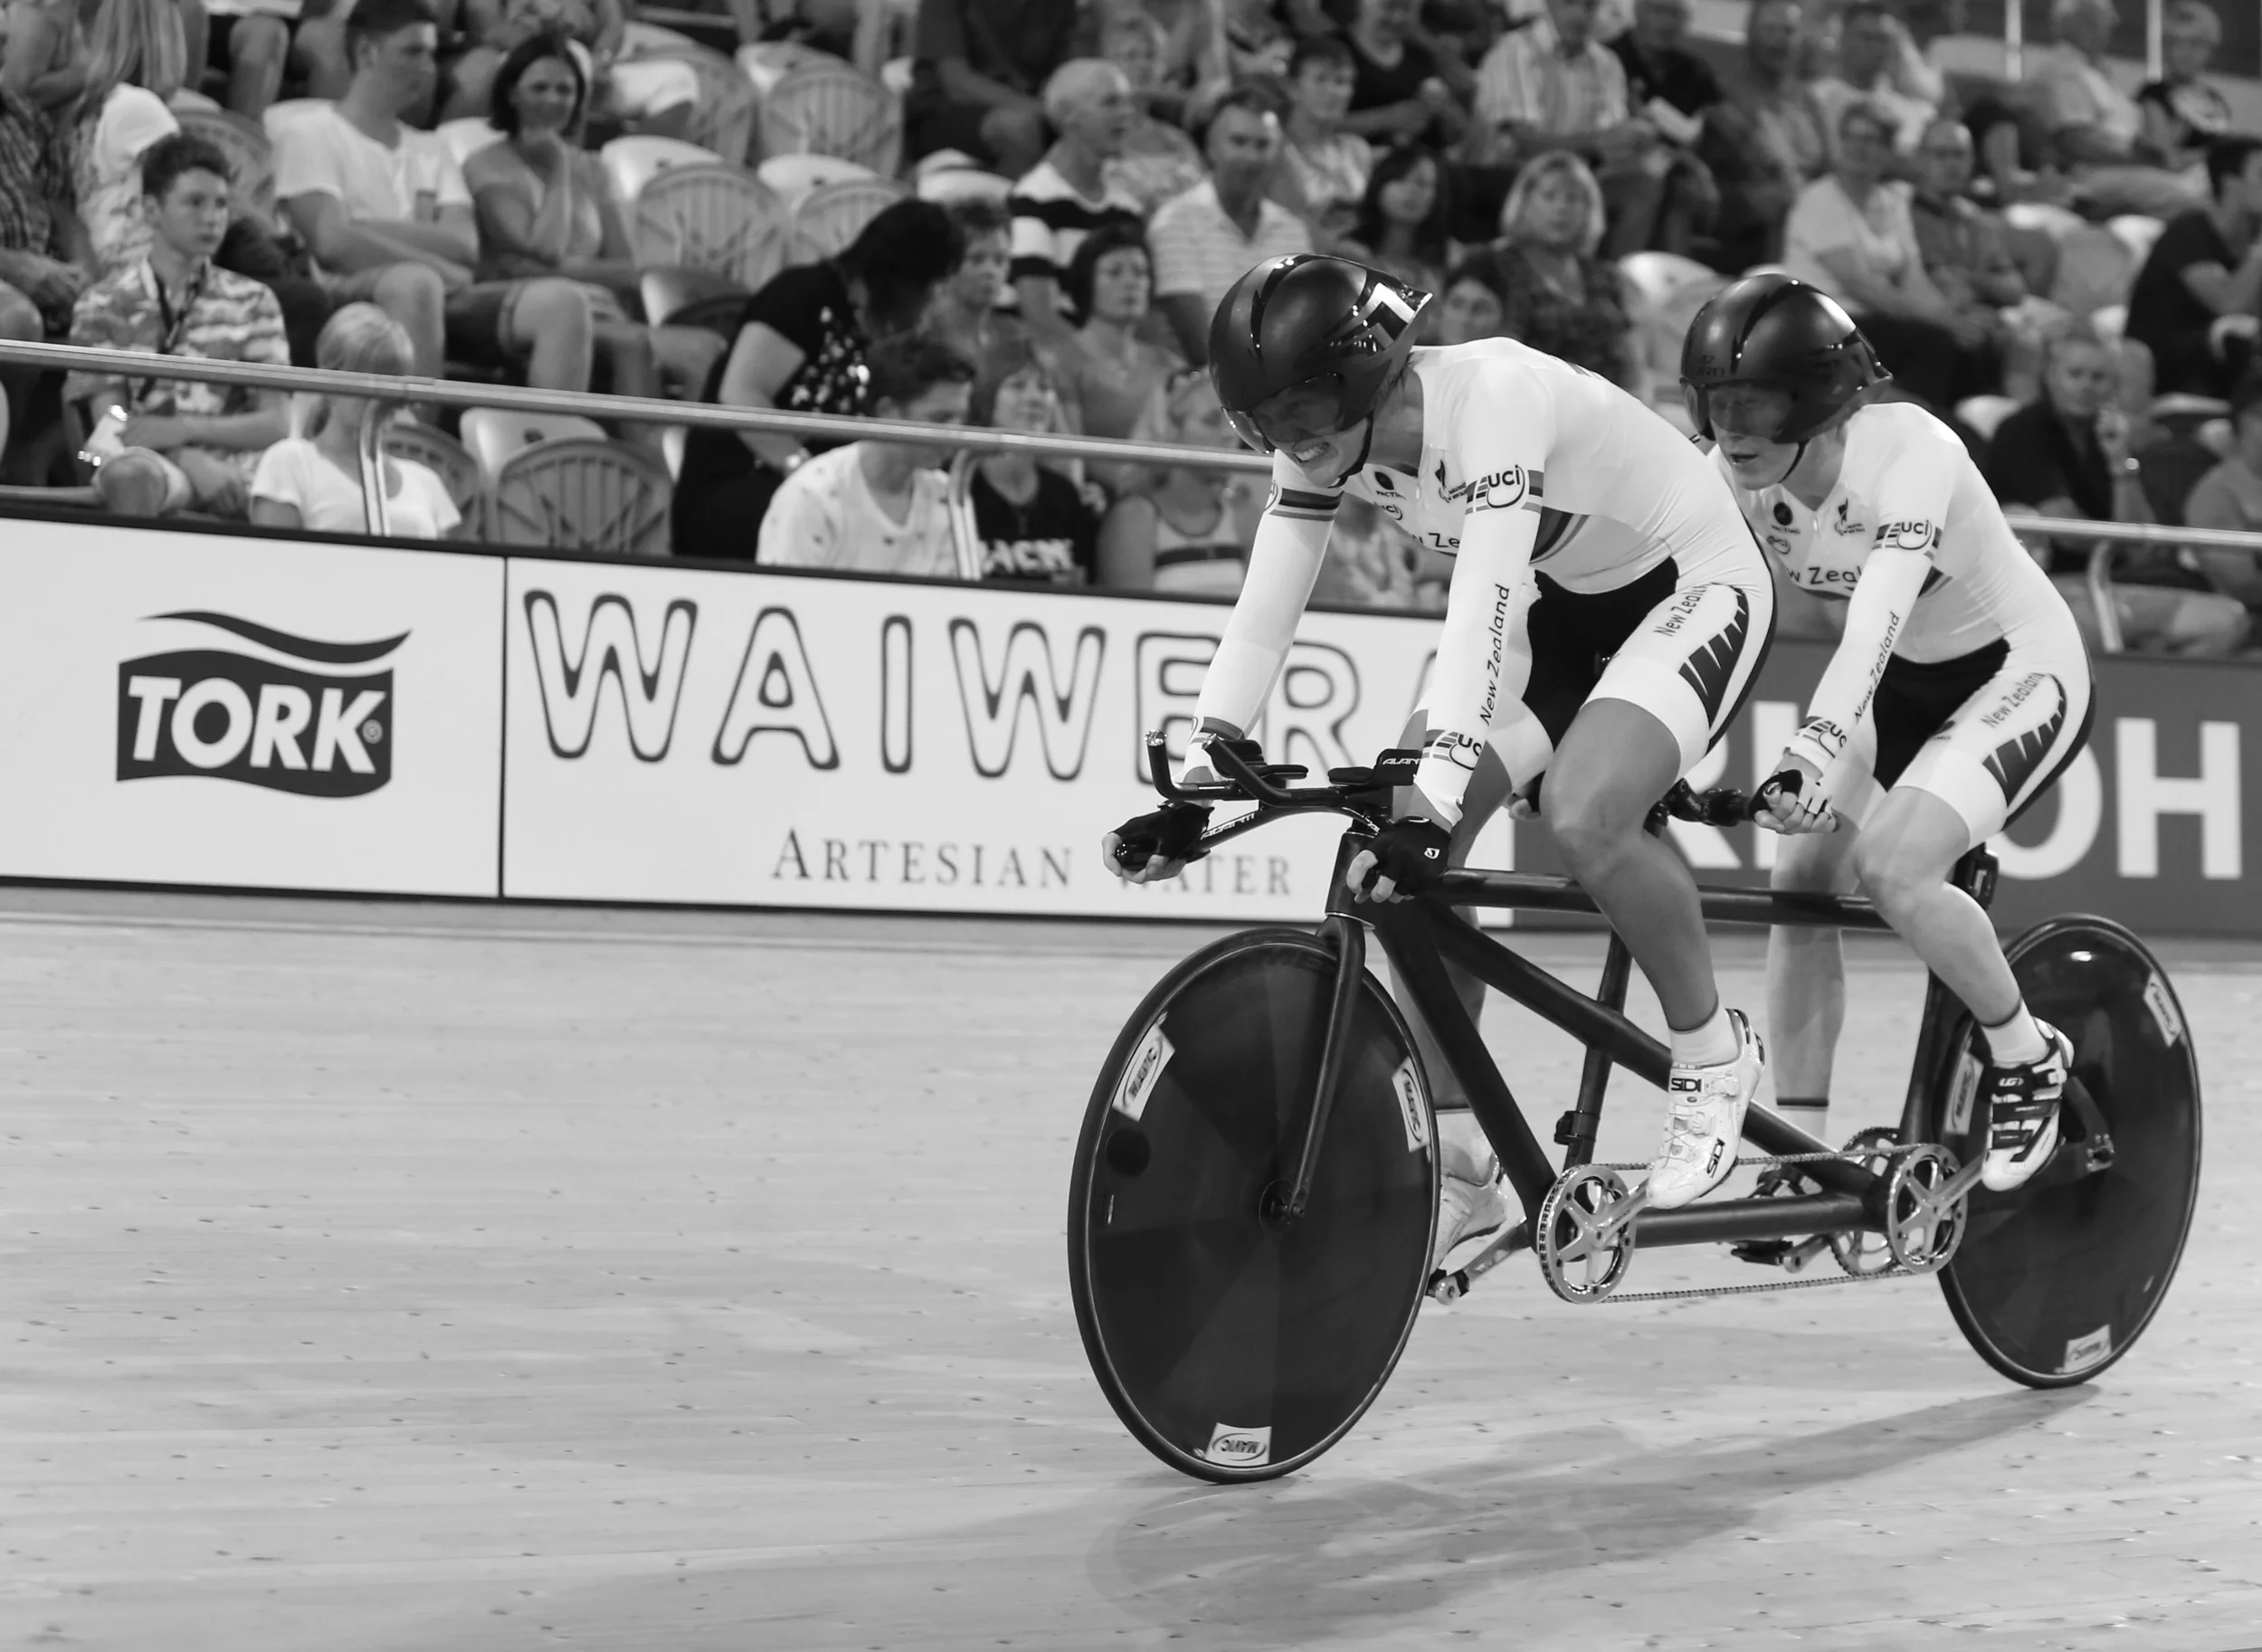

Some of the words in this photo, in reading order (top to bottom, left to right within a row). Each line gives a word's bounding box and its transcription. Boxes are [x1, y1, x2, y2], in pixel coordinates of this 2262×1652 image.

[1487, 583, 1510, 679] Zealand
[1653, 613, 1687, 638] New
[522, 589, 1439, 785] WAIWER
[1854, 688, 1874, 724] New
[1869, 611, 1900, 686] Zealand
[1479, 679, 1497, 726] New
[1981, 706, 2012, 728] New
[2001, 672, 2045, 708] Zealan
[1382, 757, 1421, 766] AVANT
[771, 827, 1072, 888] ARTESIAN
[1670, 1077, 1702, 1093] SIDI
[1706, 1137, 1725, 1179] SIDI
